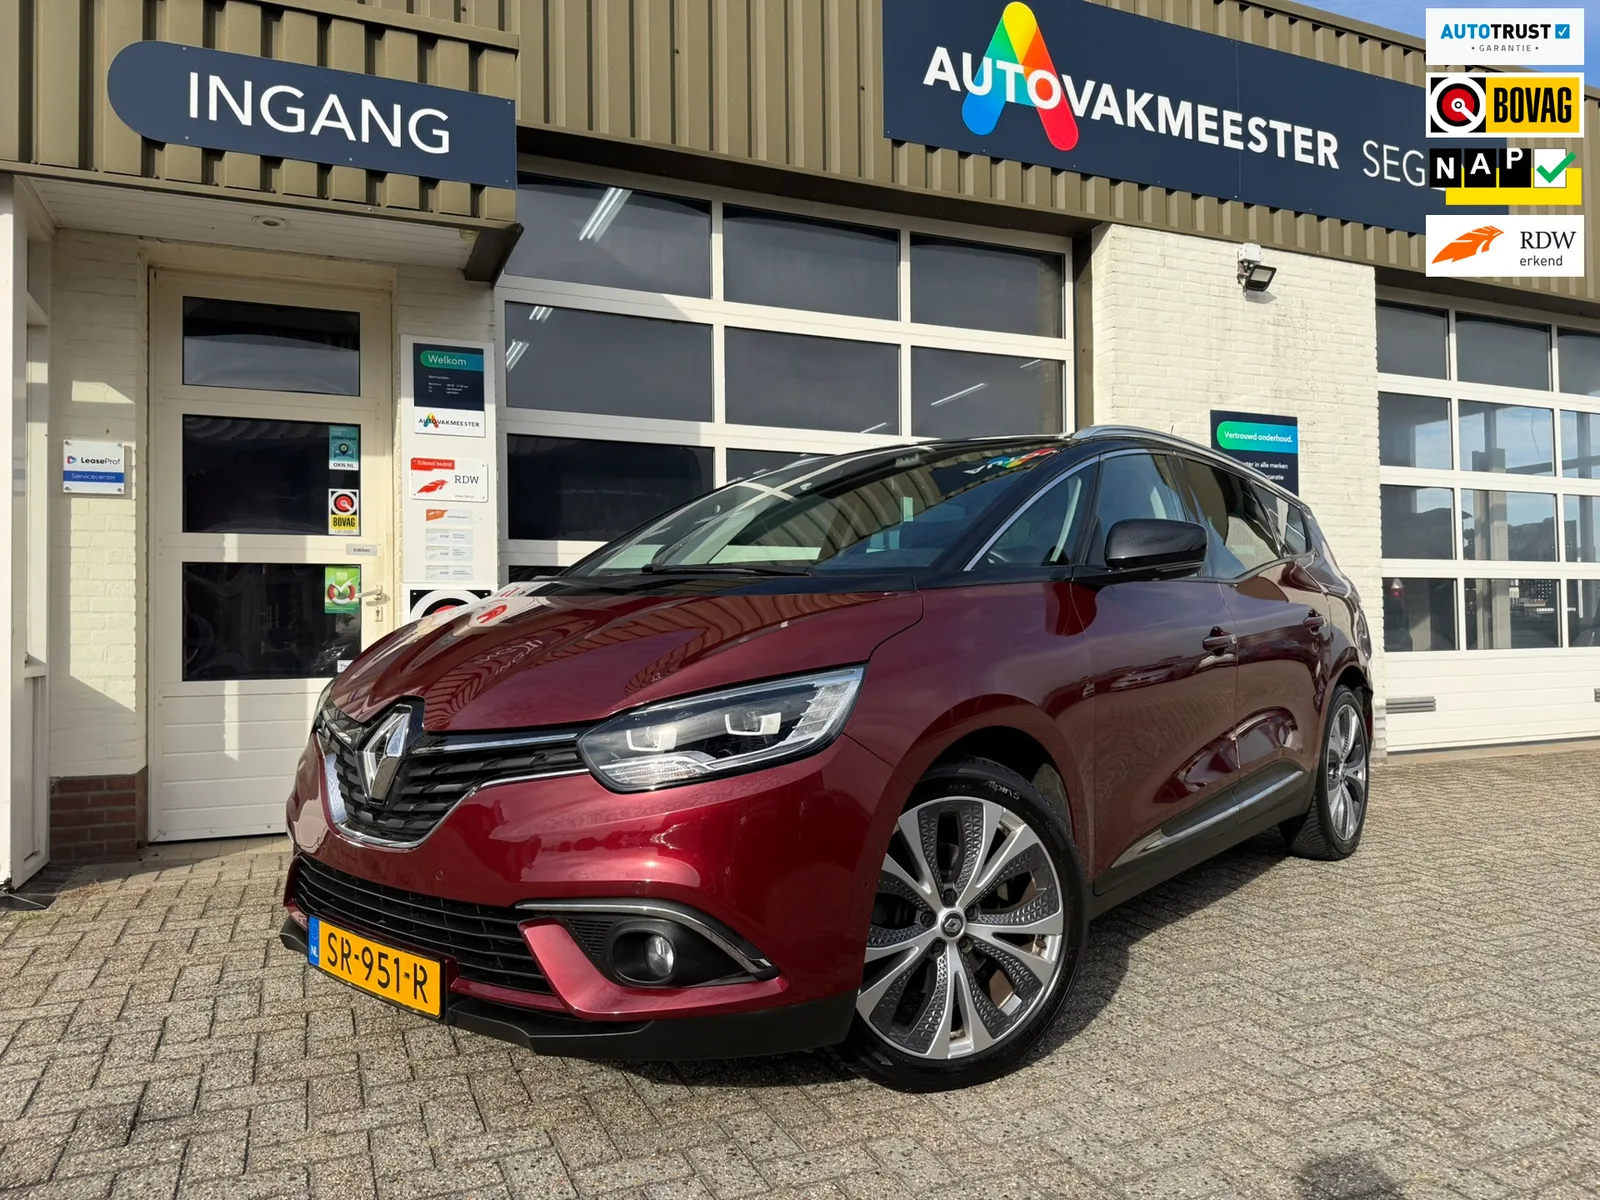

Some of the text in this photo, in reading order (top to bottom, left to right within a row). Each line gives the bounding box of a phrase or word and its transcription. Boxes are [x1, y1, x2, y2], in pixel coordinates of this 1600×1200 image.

[189, 71, 450, 155] INGANG
[922, 45, 1426, 188] AUTOVAKMEESTER SEG
[428, 354, 467, 366] Welkom
[418, 418, 480, 427] AUTOVAKMEESTER
[1224, 430, 1293, 443] Vertrouwd onderhoud.
[71, 472, 117, 481] Servicecenter
[454, 474, 480, 484] RDW
[333, 516, 356, 528] BOVAG
[327, 931, 429, 1004] SR-951-R
